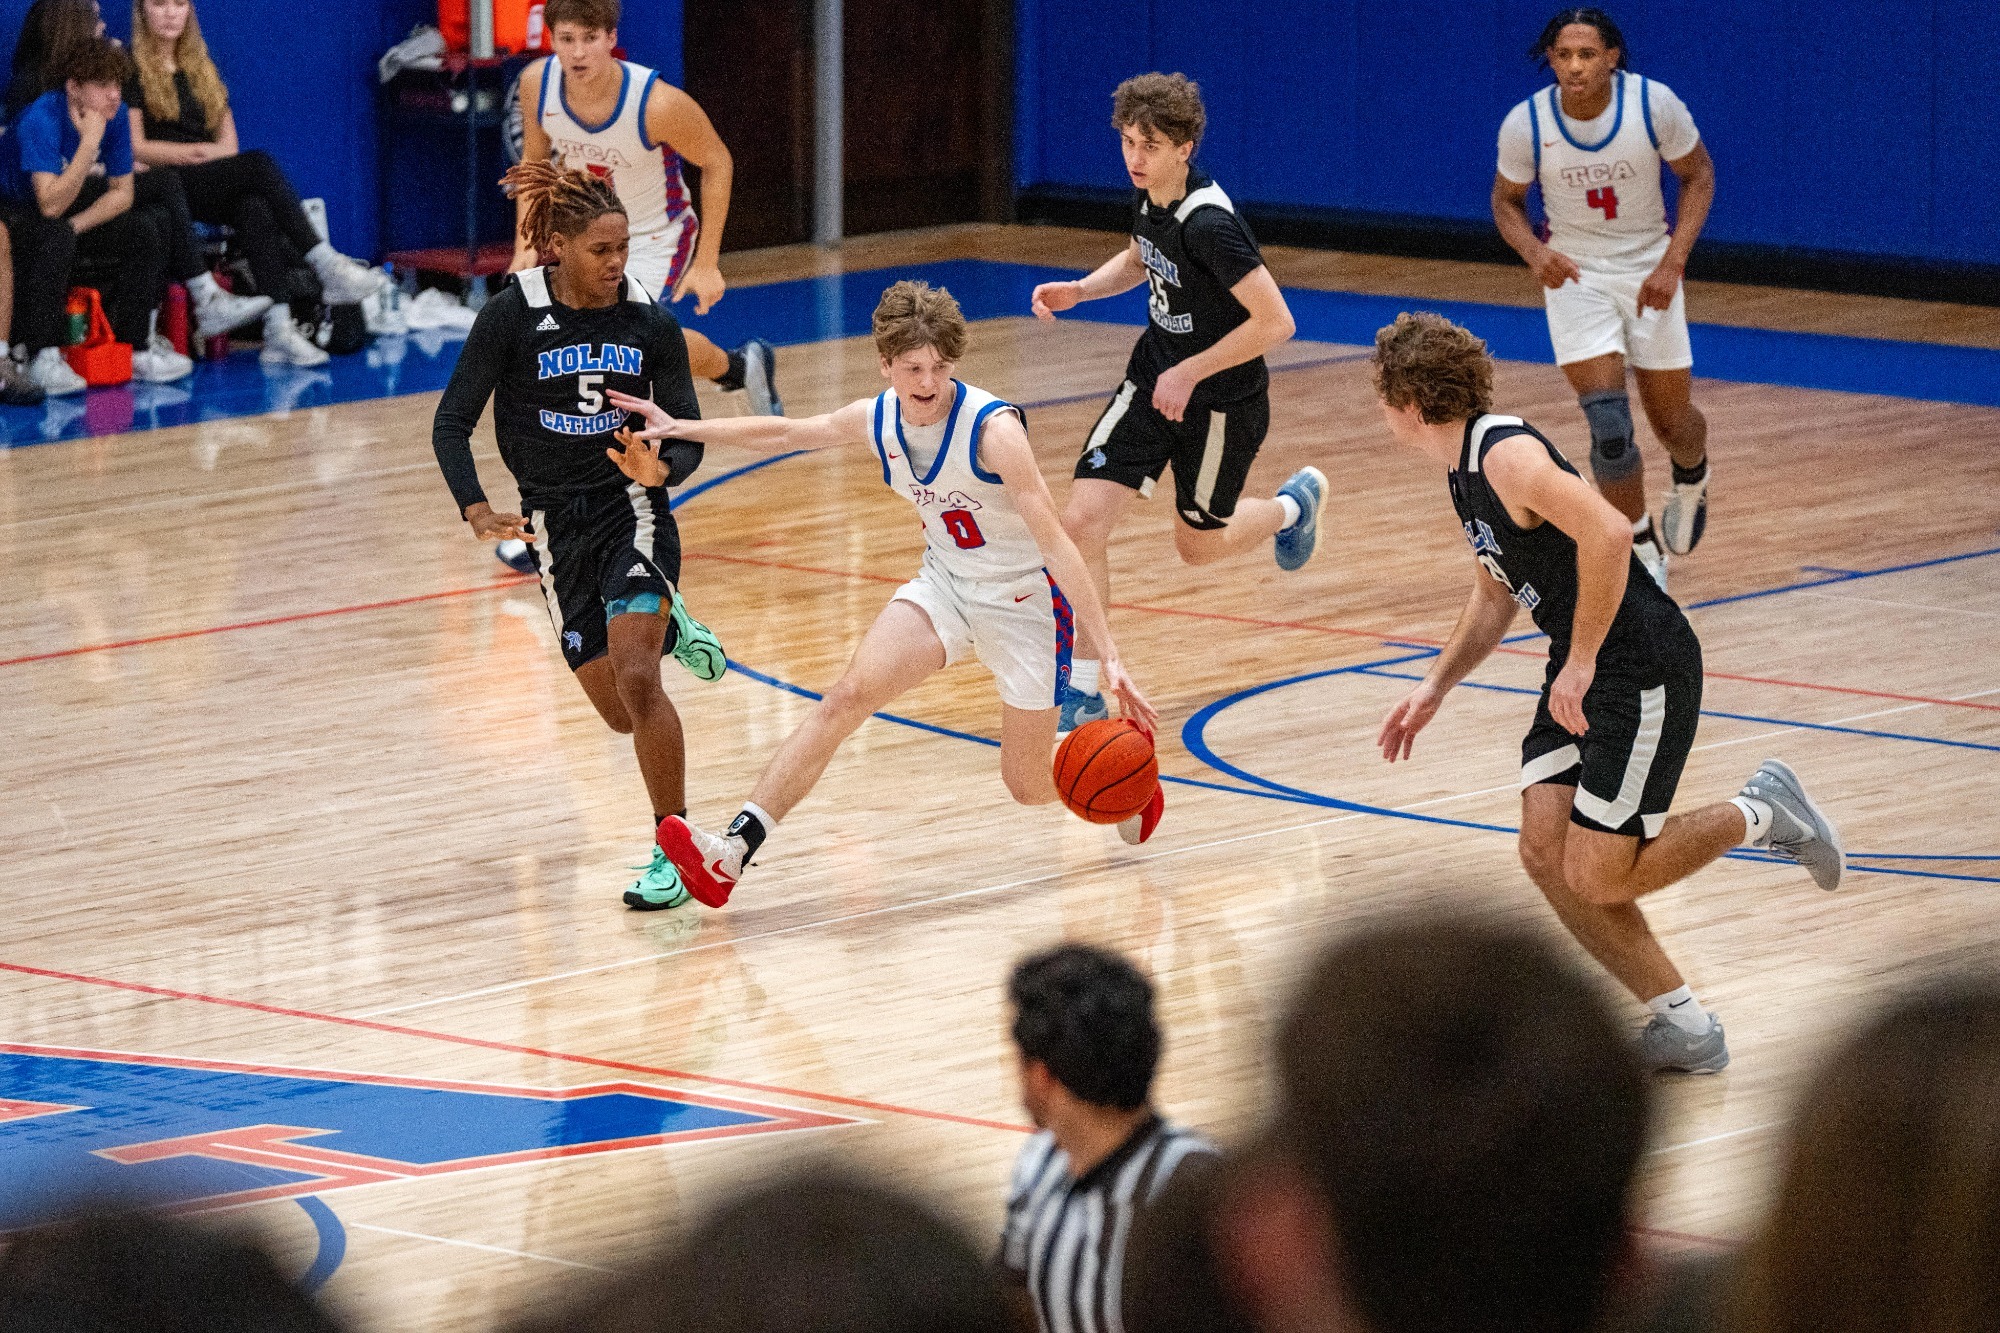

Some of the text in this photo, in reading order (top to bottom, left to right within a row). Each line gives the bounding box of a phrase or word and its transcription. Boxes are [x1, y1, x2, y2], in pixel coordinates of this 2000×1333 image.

[1561, 160, 1637, 188] TCA
[1586, 186, 1619, 221] 4
[536, 323, 560, 331] adidas
[538, 343, 643, 380] NOLAN
[578, 374, 604, 415] 5
[940, 508, 987, 550] 0
